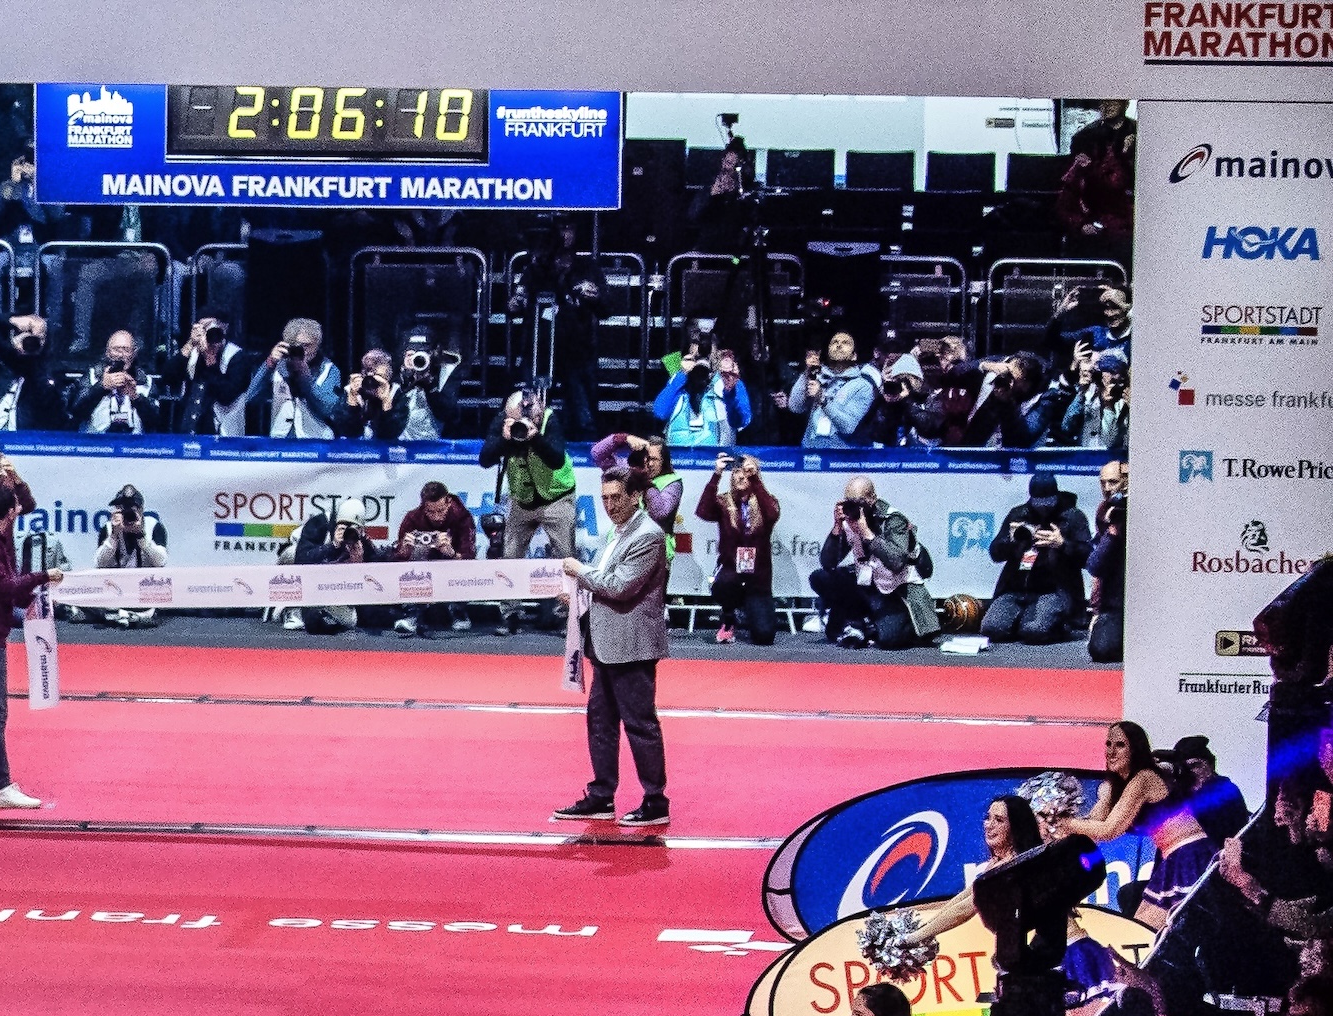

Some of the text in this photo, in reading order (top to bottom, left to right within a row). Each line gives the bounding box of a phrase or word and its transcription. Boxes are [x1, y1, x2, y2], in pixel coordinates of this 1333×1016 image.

[228, 86, 473, 140] 2:06:10
[68, 126, 132, 135] FRANKFURT
[68, 135, 132, 144] MARATHON
[505, 123, 607, 138] FRANKFURT
[102, 174, 552, 200] MAINOVA FRANKFURT MARATHON
[1201, 226, 1319, 260] HOKA
[1201, 305, 1322, 325] SPORTSTADT
[1206, 393, 1266, 407] messe
[214, 491, 395, 522] SPORTSTDT
[214, 540, 283, 552] FRANKF
[268, 916, 598, 937] messe
